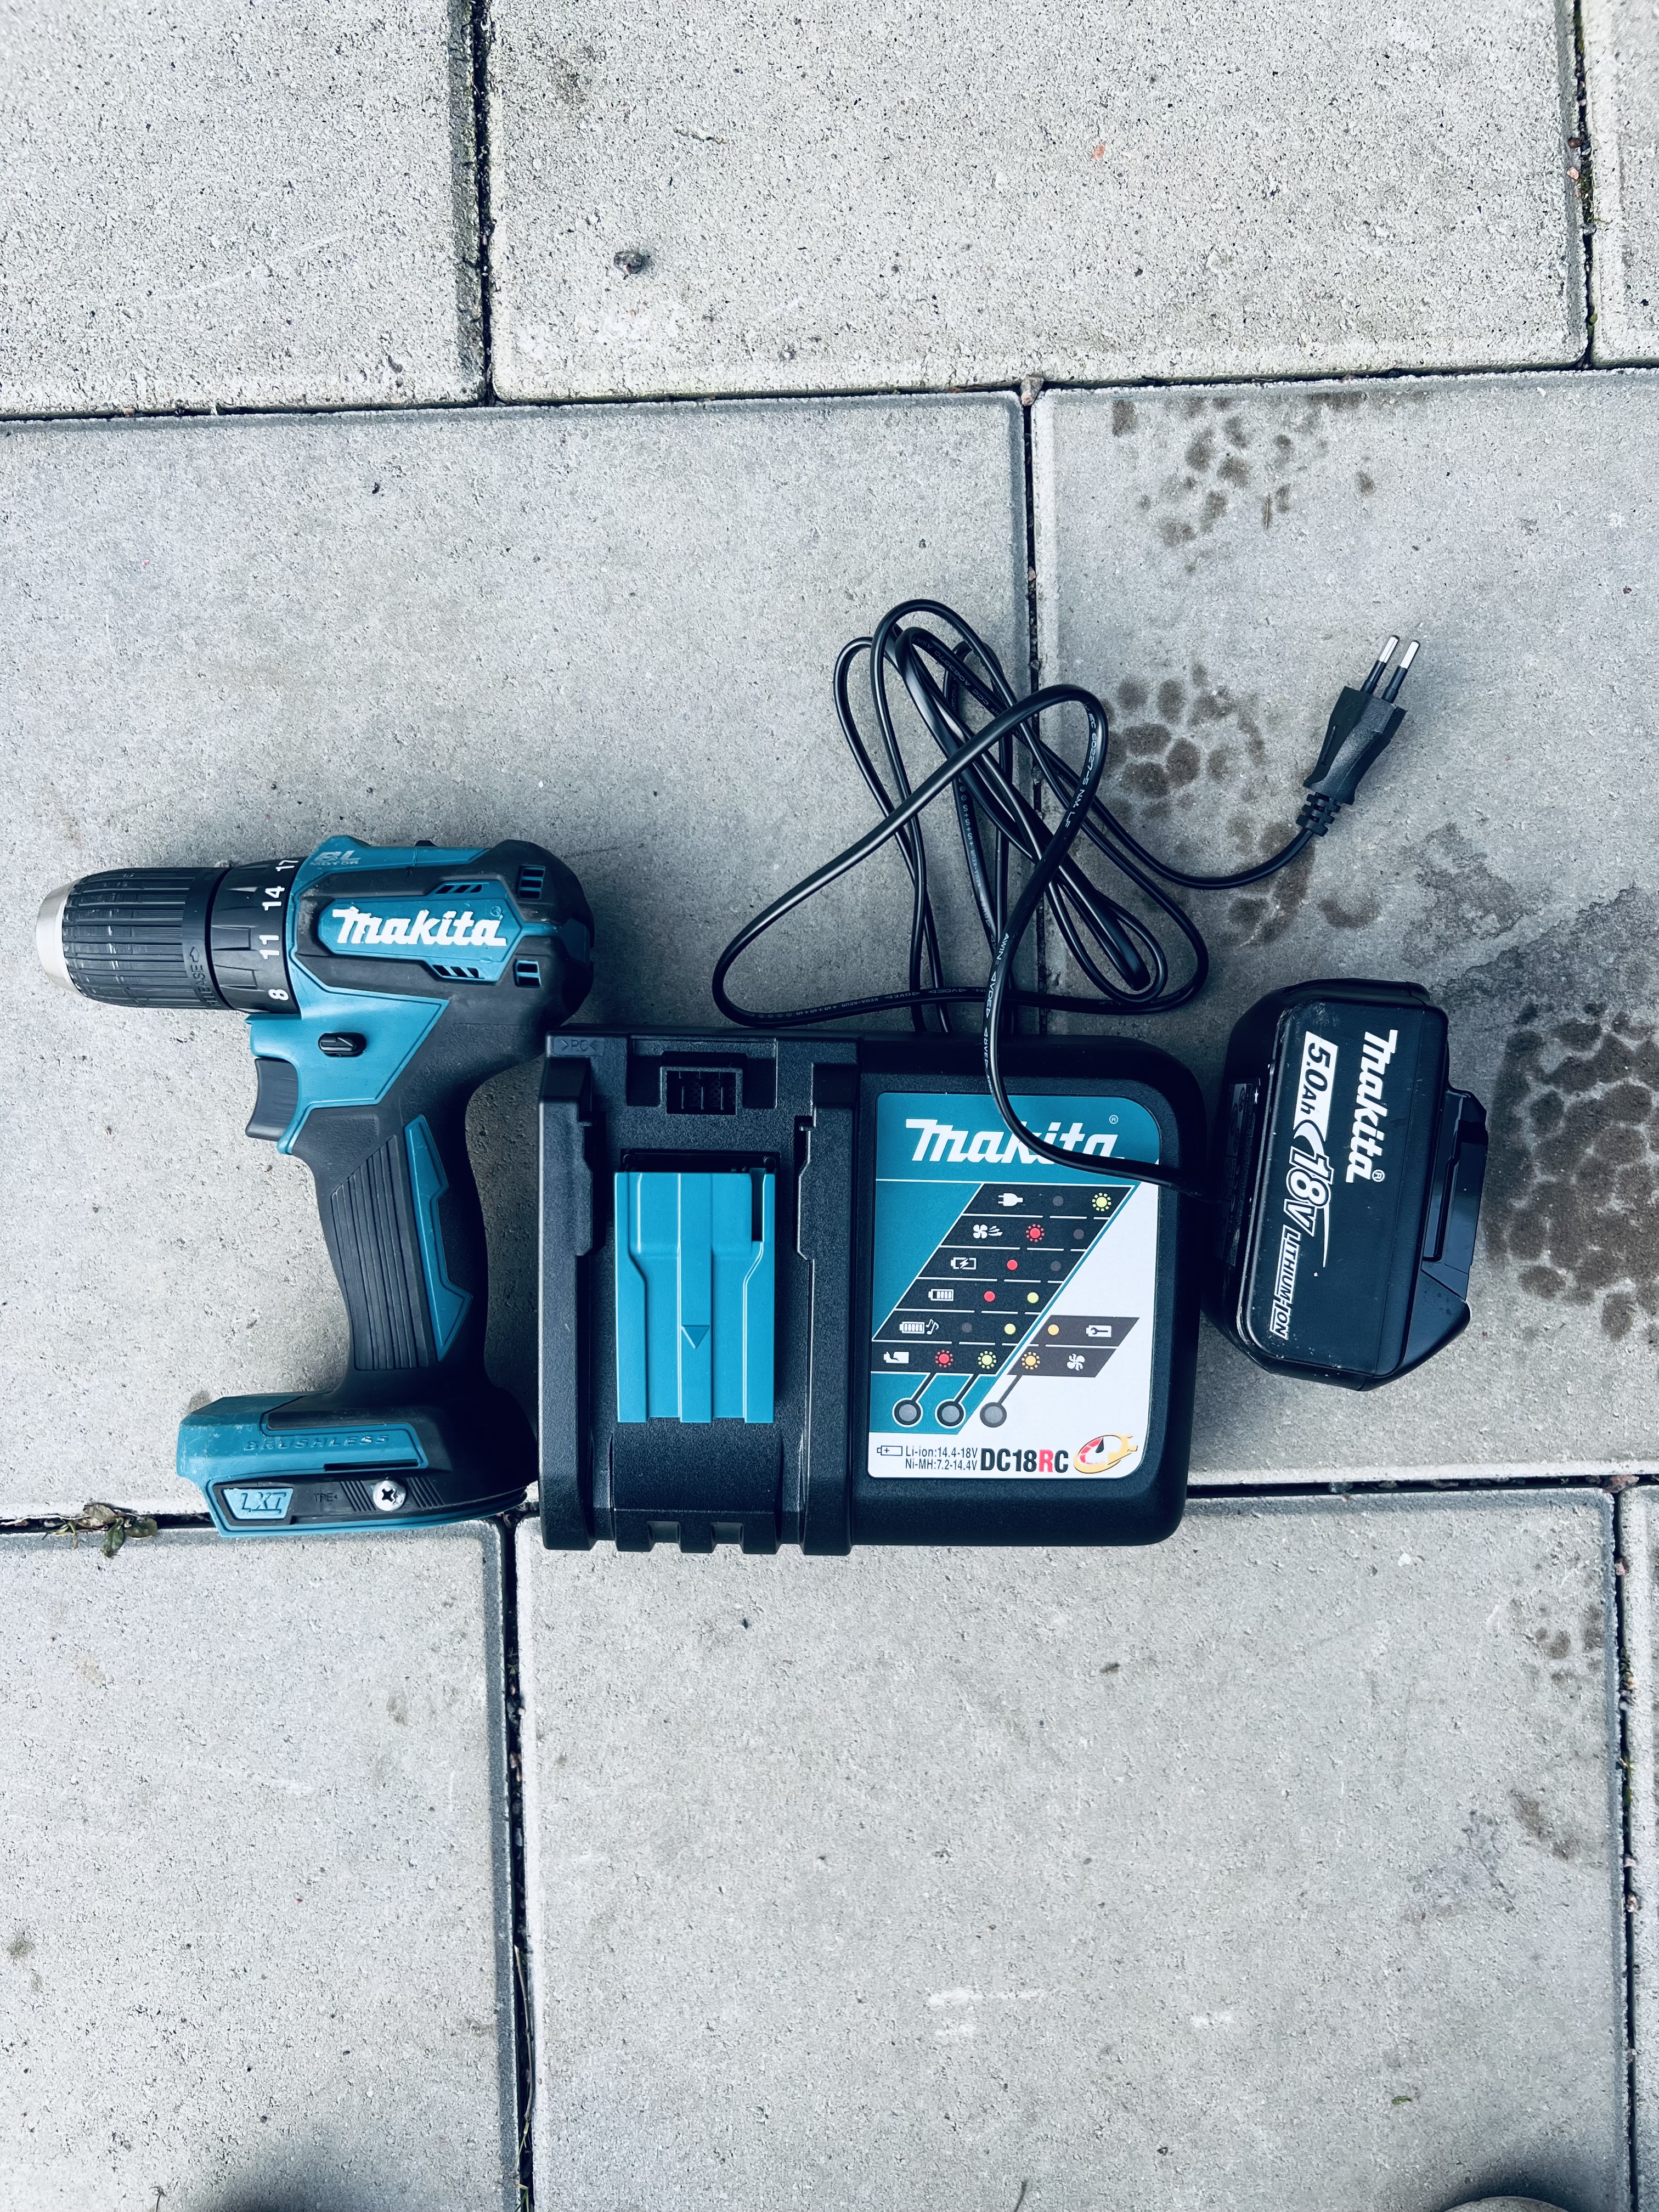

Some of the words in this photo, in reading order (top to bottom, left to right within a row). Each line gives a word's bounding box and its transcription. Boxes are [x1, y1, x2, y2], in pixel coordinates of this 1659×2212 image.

[275, 860, 298, 871] 17
[314, 850, 362, 861] BL
[262, 885, 285, 911] 14
[258, 934, 280, 960] 11
[268, 989, 289, 1001] 8
[1300, 1042, 1329, 1116] 5.0Ah
[1284, 1147, 1335, 1237] 18V
[243, 1434, 390, 1451] BRUSHLESS
[980, 1448, 1069, 1473] DC18RC
[241, 1492, 286, 1513] LXT
